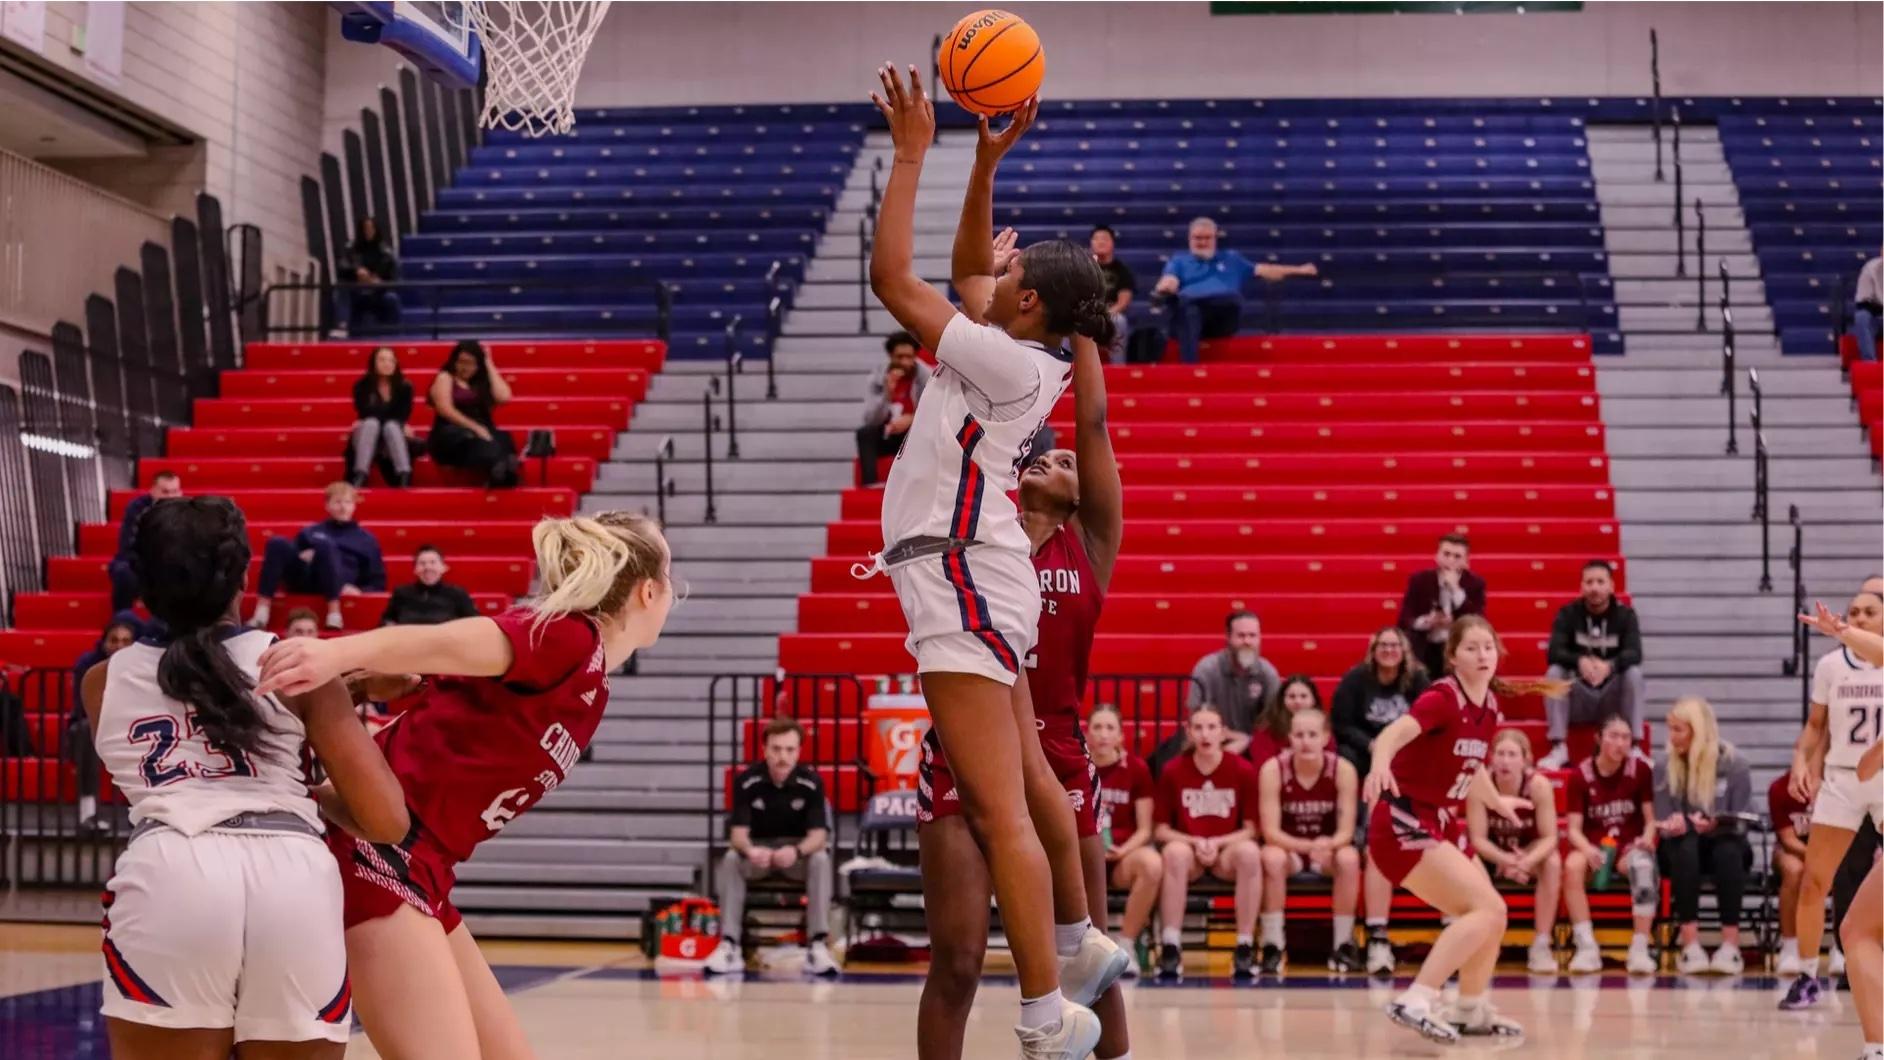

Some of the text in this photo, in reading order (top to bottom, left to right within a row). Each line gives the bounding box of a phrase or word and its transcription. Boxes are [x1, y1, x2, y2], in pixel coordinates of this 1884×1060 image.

[1039, 568, 1081, 594] RON
[890, 722, 915, 751] G
[874, 797, 918, 817] PAC
